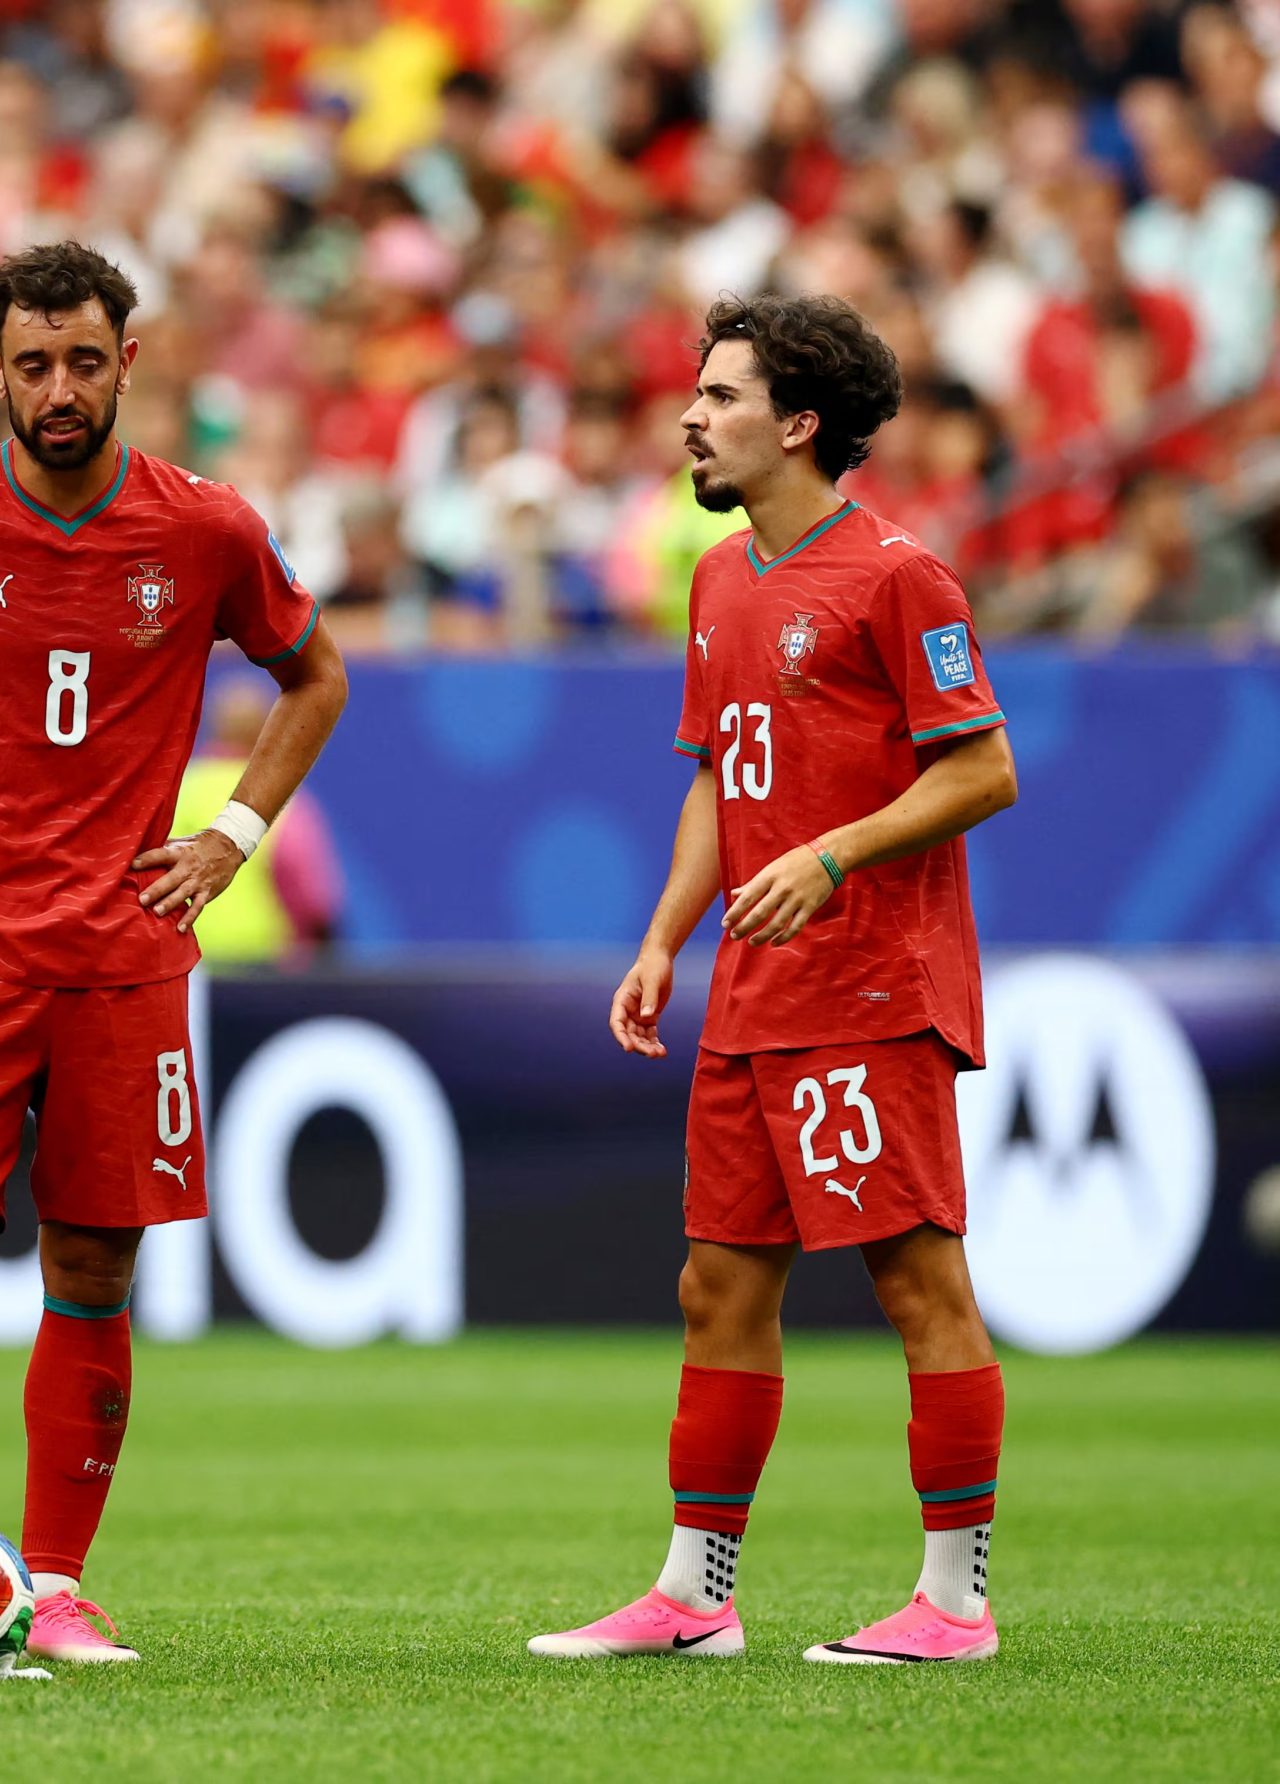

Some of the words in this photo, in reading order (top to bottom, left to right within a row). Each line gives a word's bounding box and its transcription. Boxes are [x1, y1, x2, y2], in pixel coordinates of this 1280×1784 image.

[45, 649, 91, 746] 8
[943, 660, 968, 676] PEACE
[719, 702, 773, 801] 23
[157, 1047, 192, 1146] 8
[792, 1062, 882, 1177] 23
